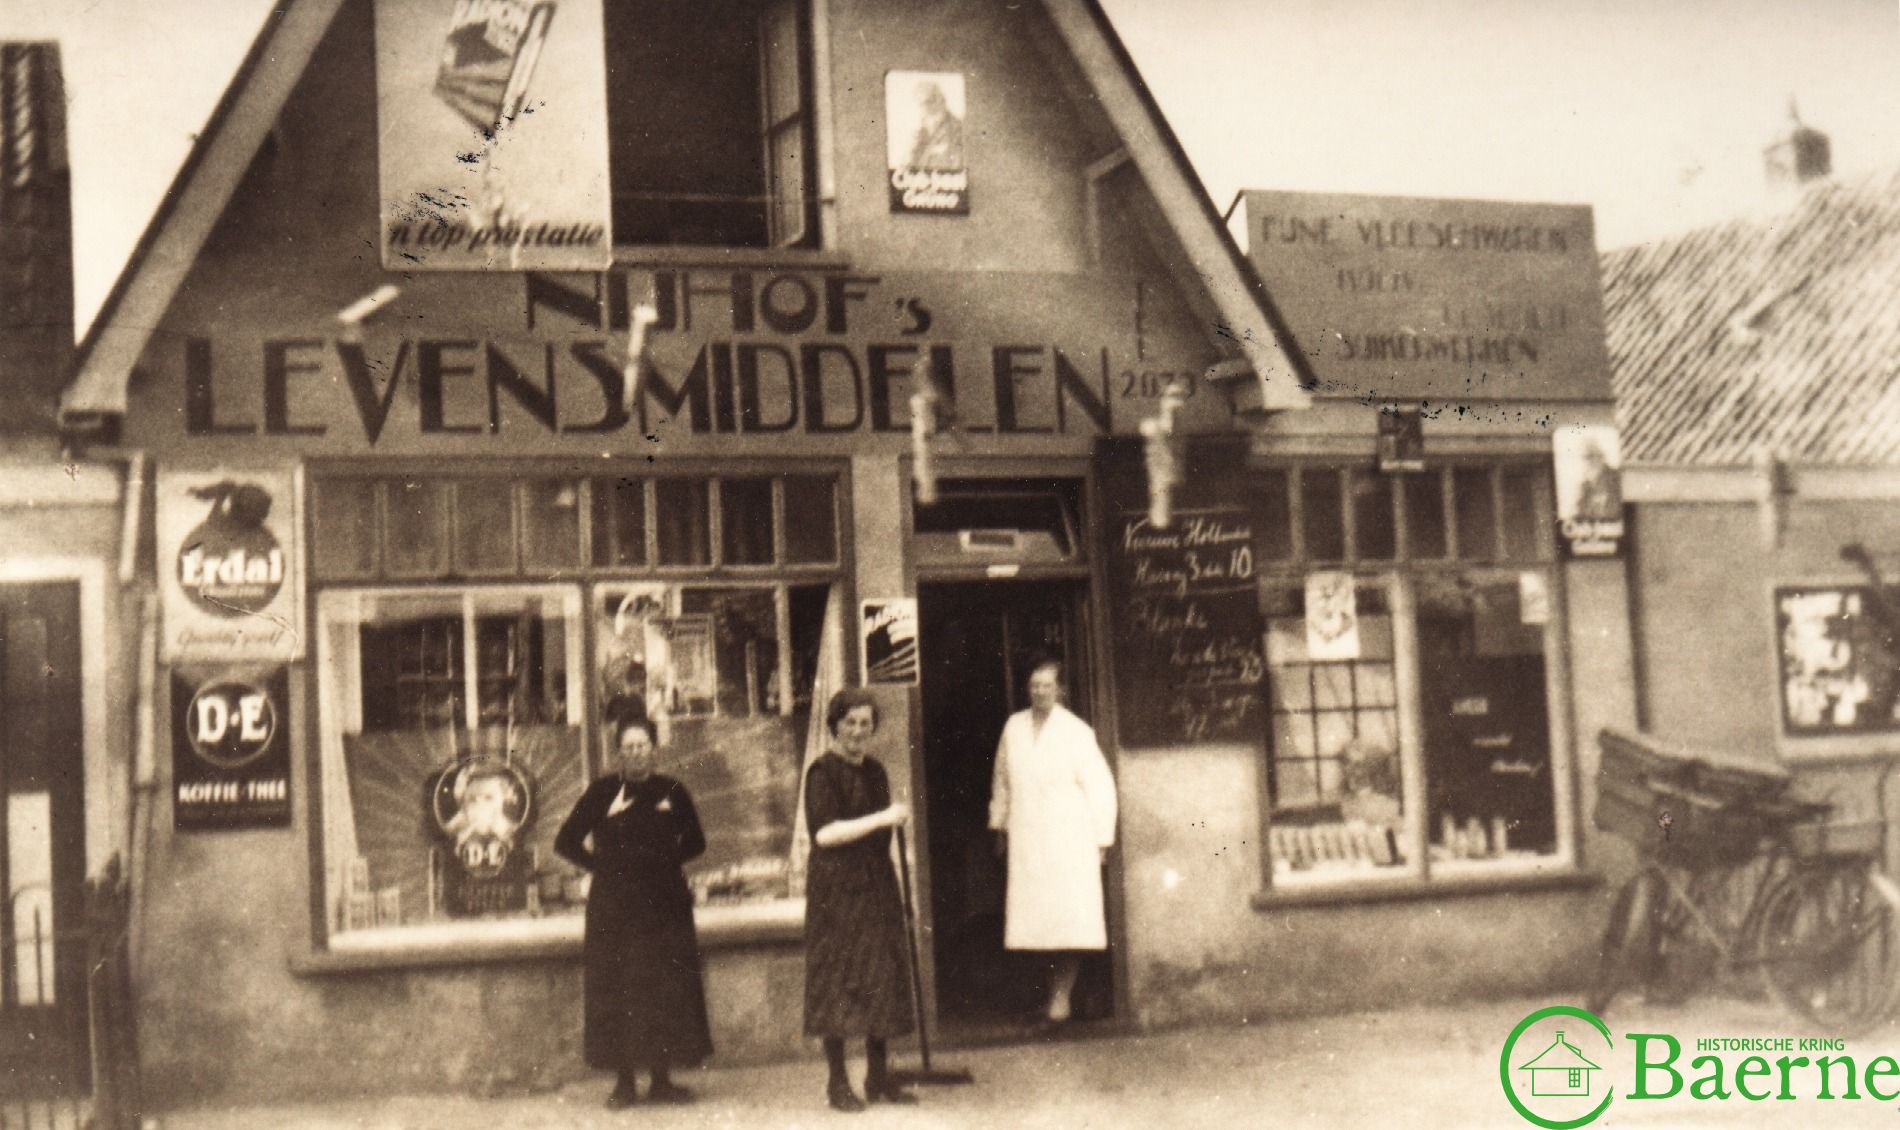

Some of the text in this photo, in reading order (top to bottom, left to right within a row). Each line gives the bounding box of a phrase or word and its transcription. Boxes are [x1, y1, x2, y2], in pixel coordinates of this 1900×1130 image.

[184, 338, 1112, 447] LEVENSMIDDELEN
[182, 548, 282, 587] Erdal
[1229, 545, 1252, 578] 10
